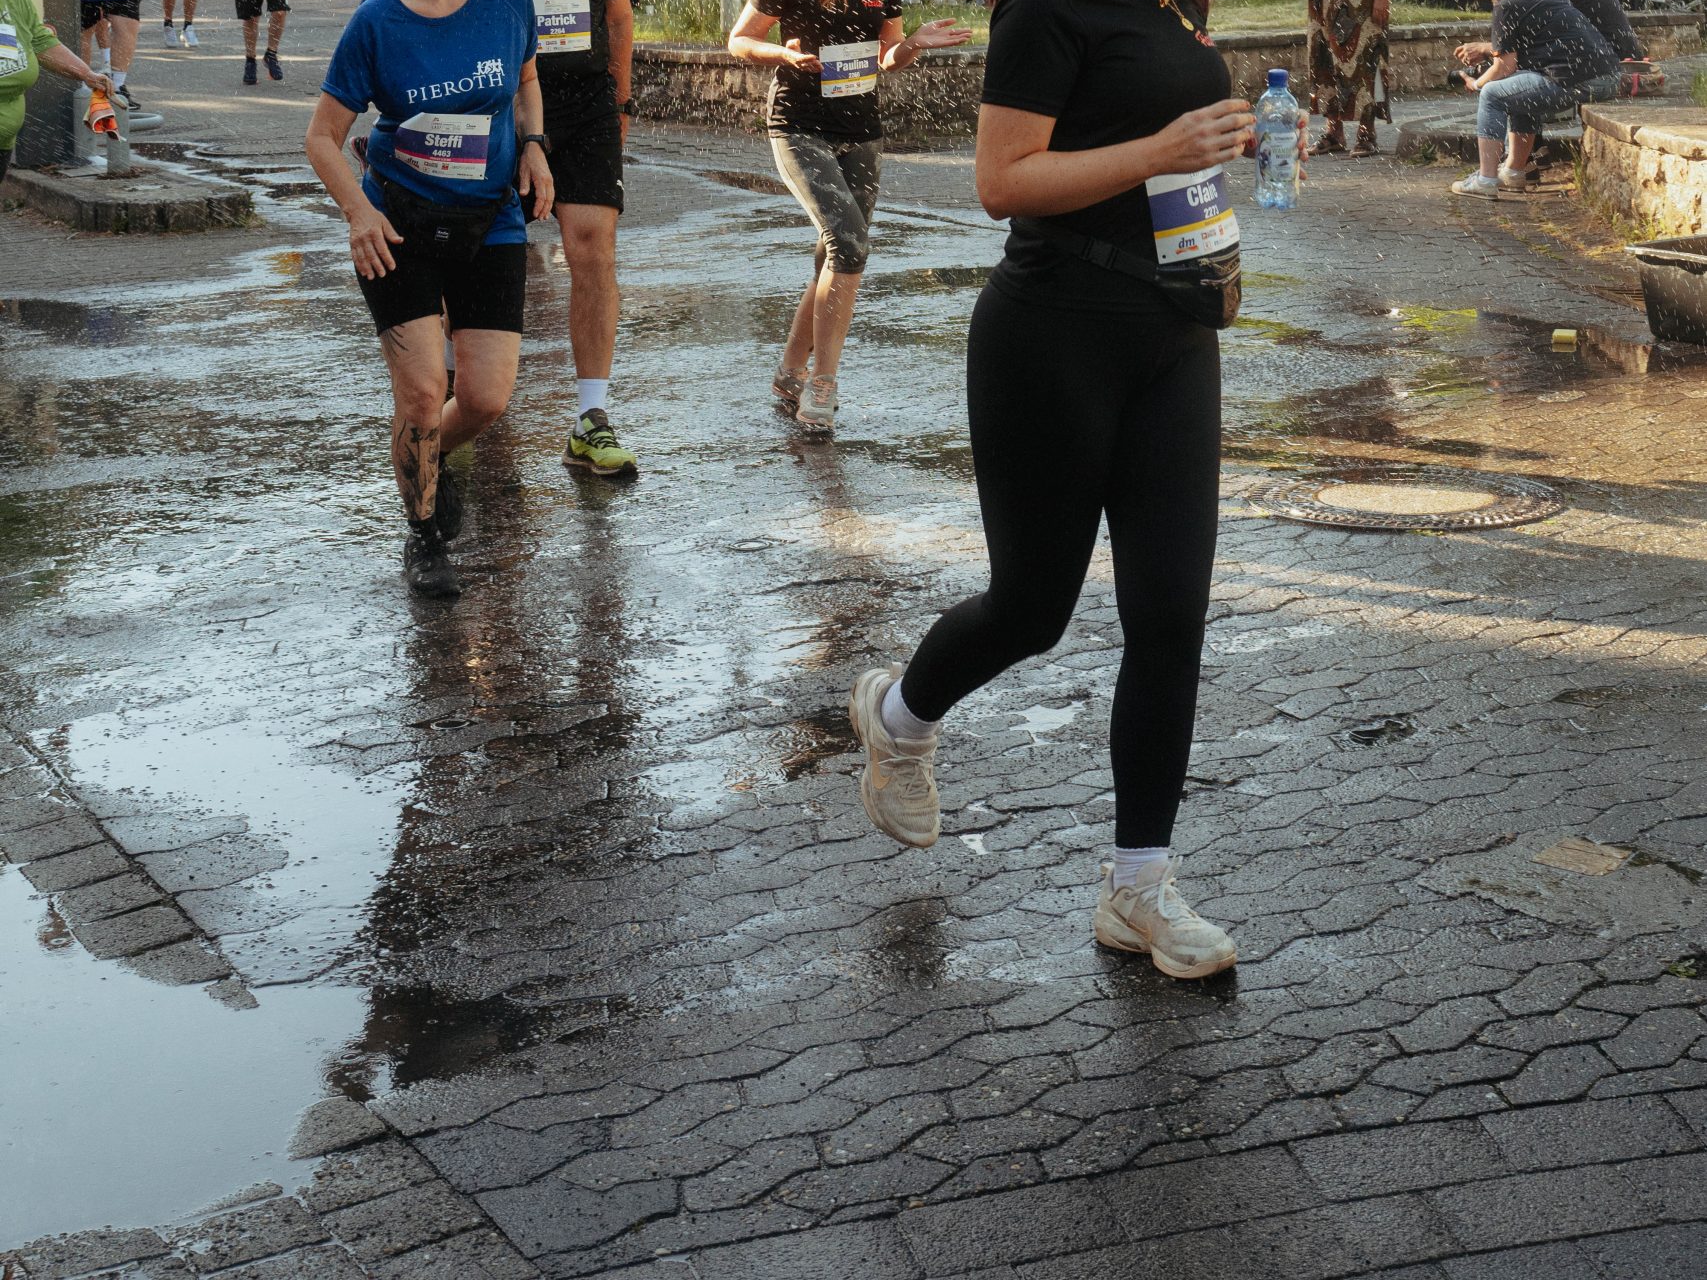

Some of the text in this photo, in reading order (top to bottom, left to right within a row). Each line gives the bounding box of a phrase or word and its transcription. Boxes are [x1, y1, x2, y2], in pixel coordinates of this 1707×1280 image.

[537, 13, 577, 27] Patrick
[836, 59, 870, 72] Paulina
[406, 73, 504, 104] PIEROTH
[424, 133, 463, 149] Steffi
[432, 149, 452, 158] 4463
[1178, 237, 1195, 249] dm
